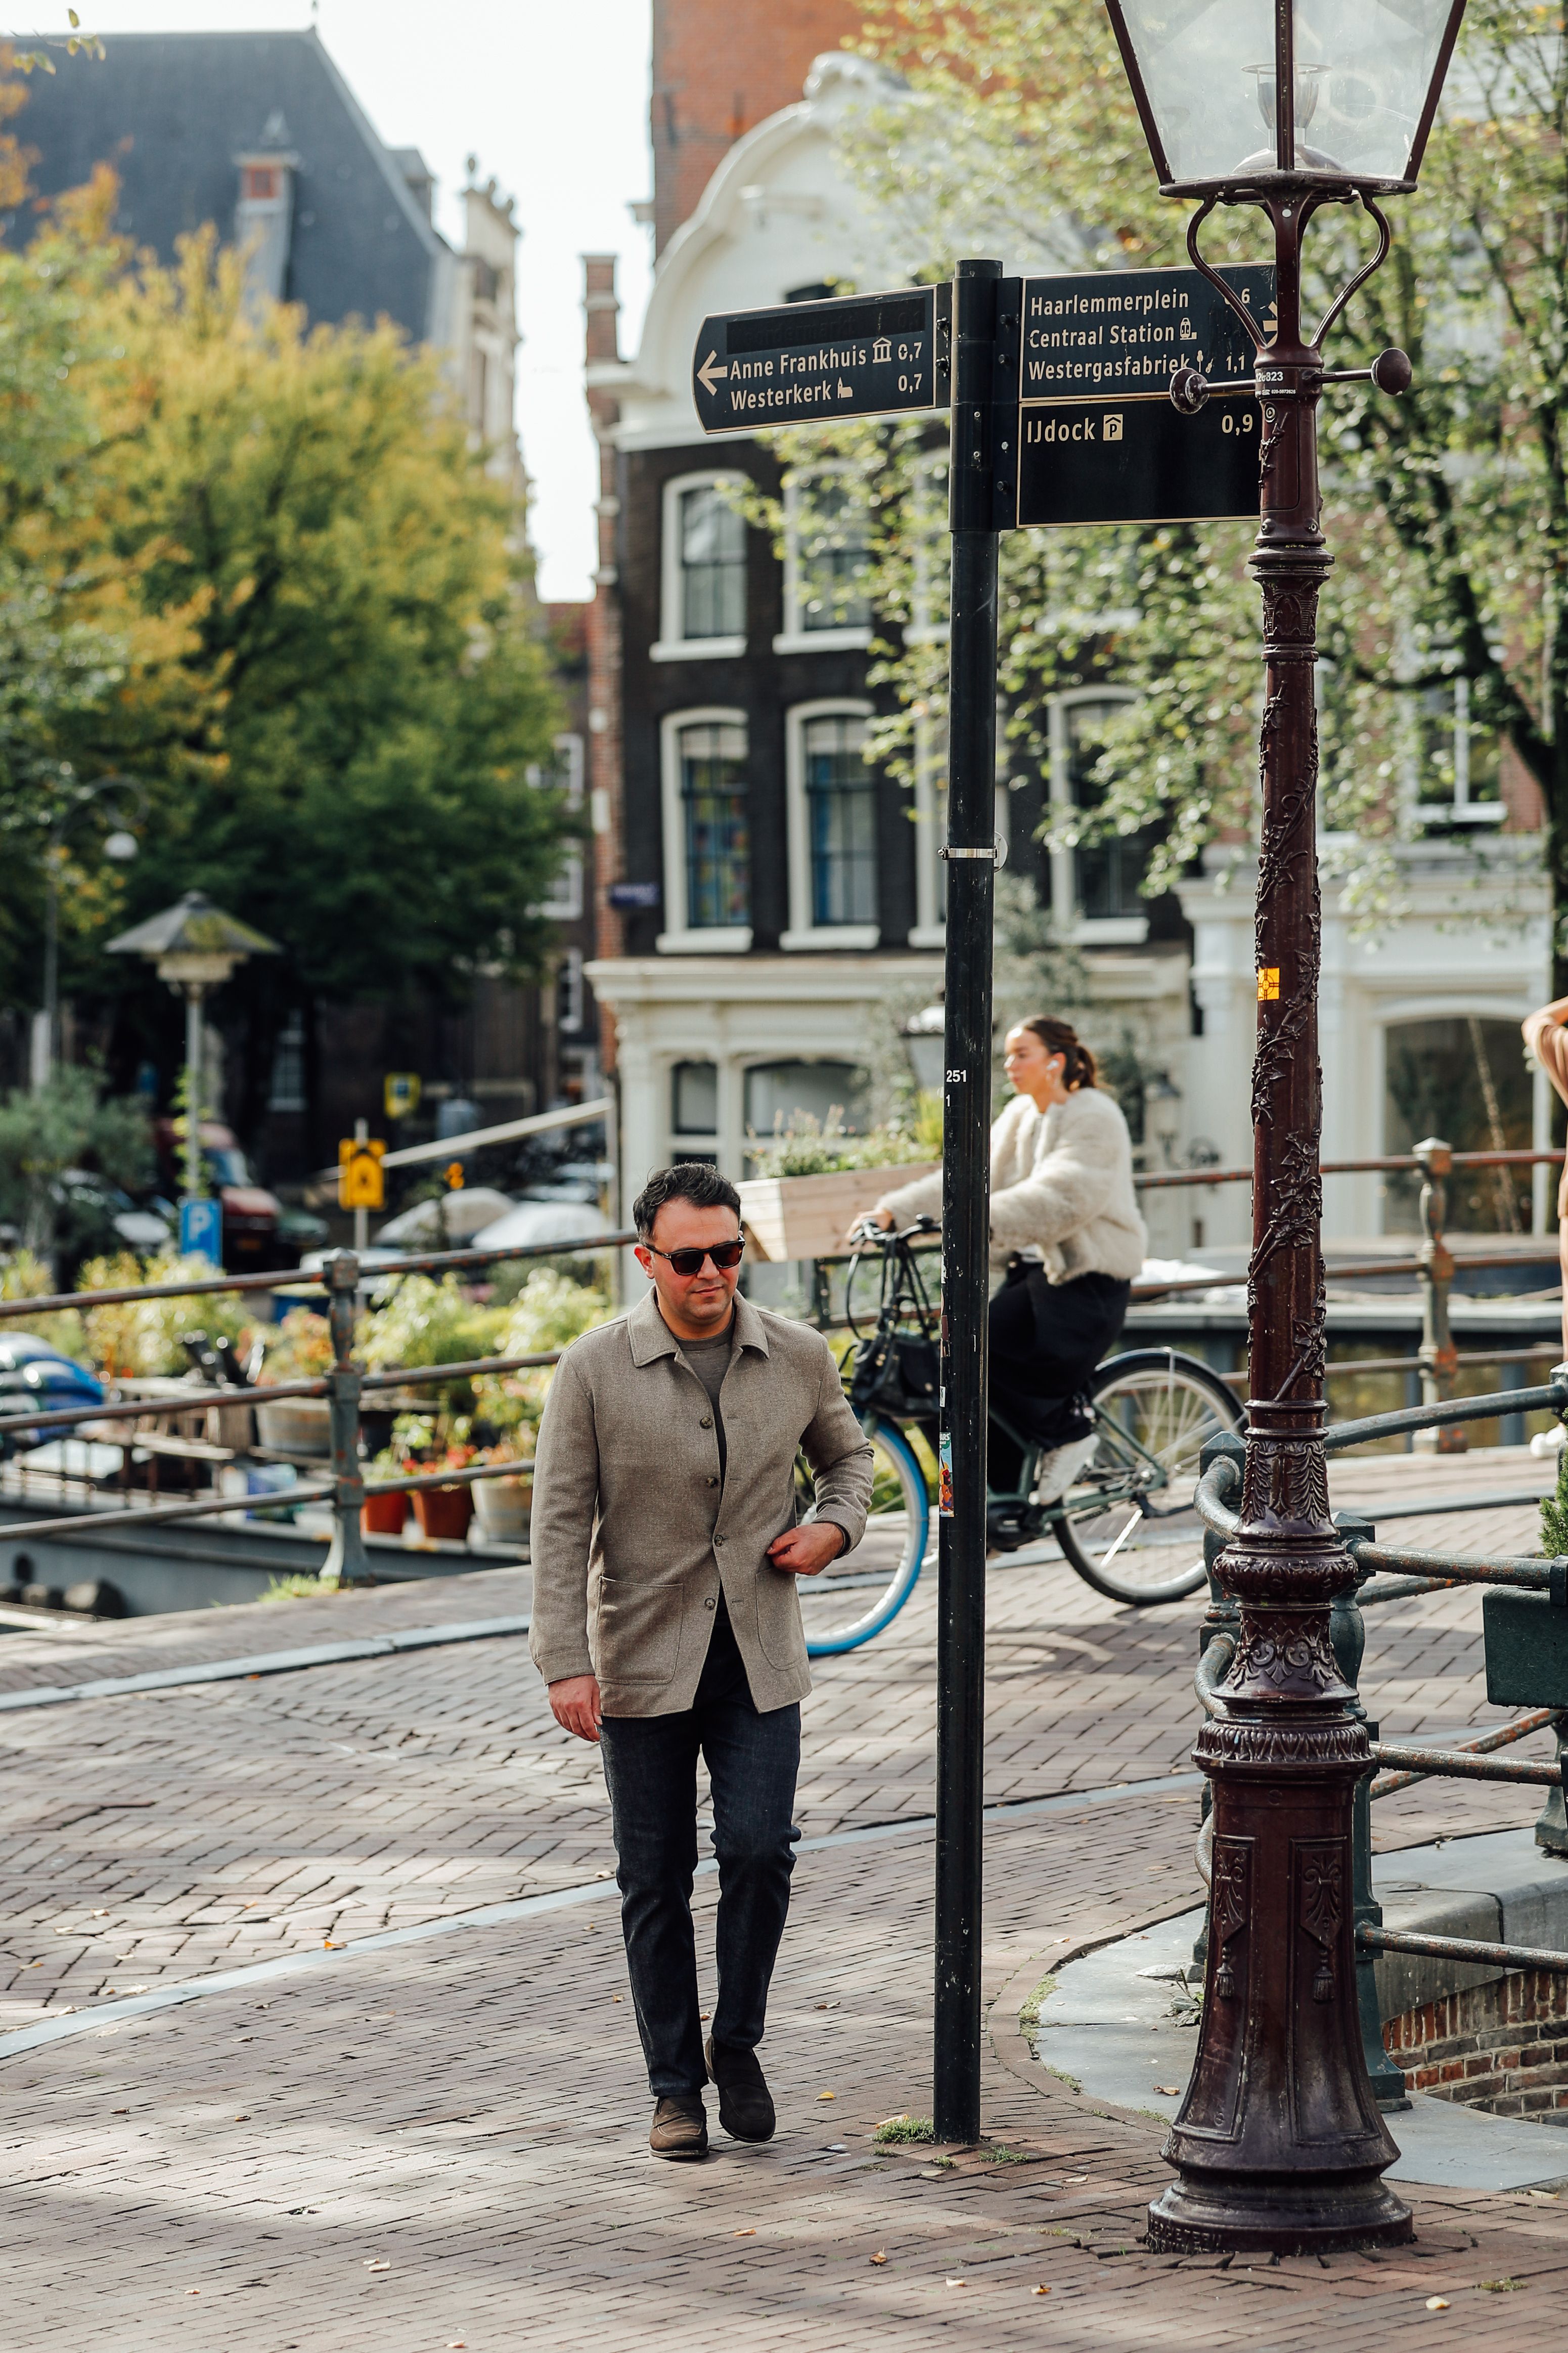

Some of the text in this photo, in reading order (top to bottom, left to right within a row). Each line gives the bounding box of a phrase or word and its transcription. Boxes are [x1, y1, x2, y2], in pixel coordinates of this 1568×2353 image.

[1031, 288, 1189, 317] Haarlemmerplein
[1029, 322, 1175, 349] Centraal Station
[730, 341, 923, 381] Anne Frankhuis 0,7
[1028, 353, 1246, 383] Westergasfabriek 1,1
[730, 373, 923, 411] Westerkerk 0,7
[1027, 417, 1096, 444] IJdock
[1221, 414, 1254, 437] 0,9
[946, 1069, 966, 1083] 251
[946, 1095, 951, 1107] 1
